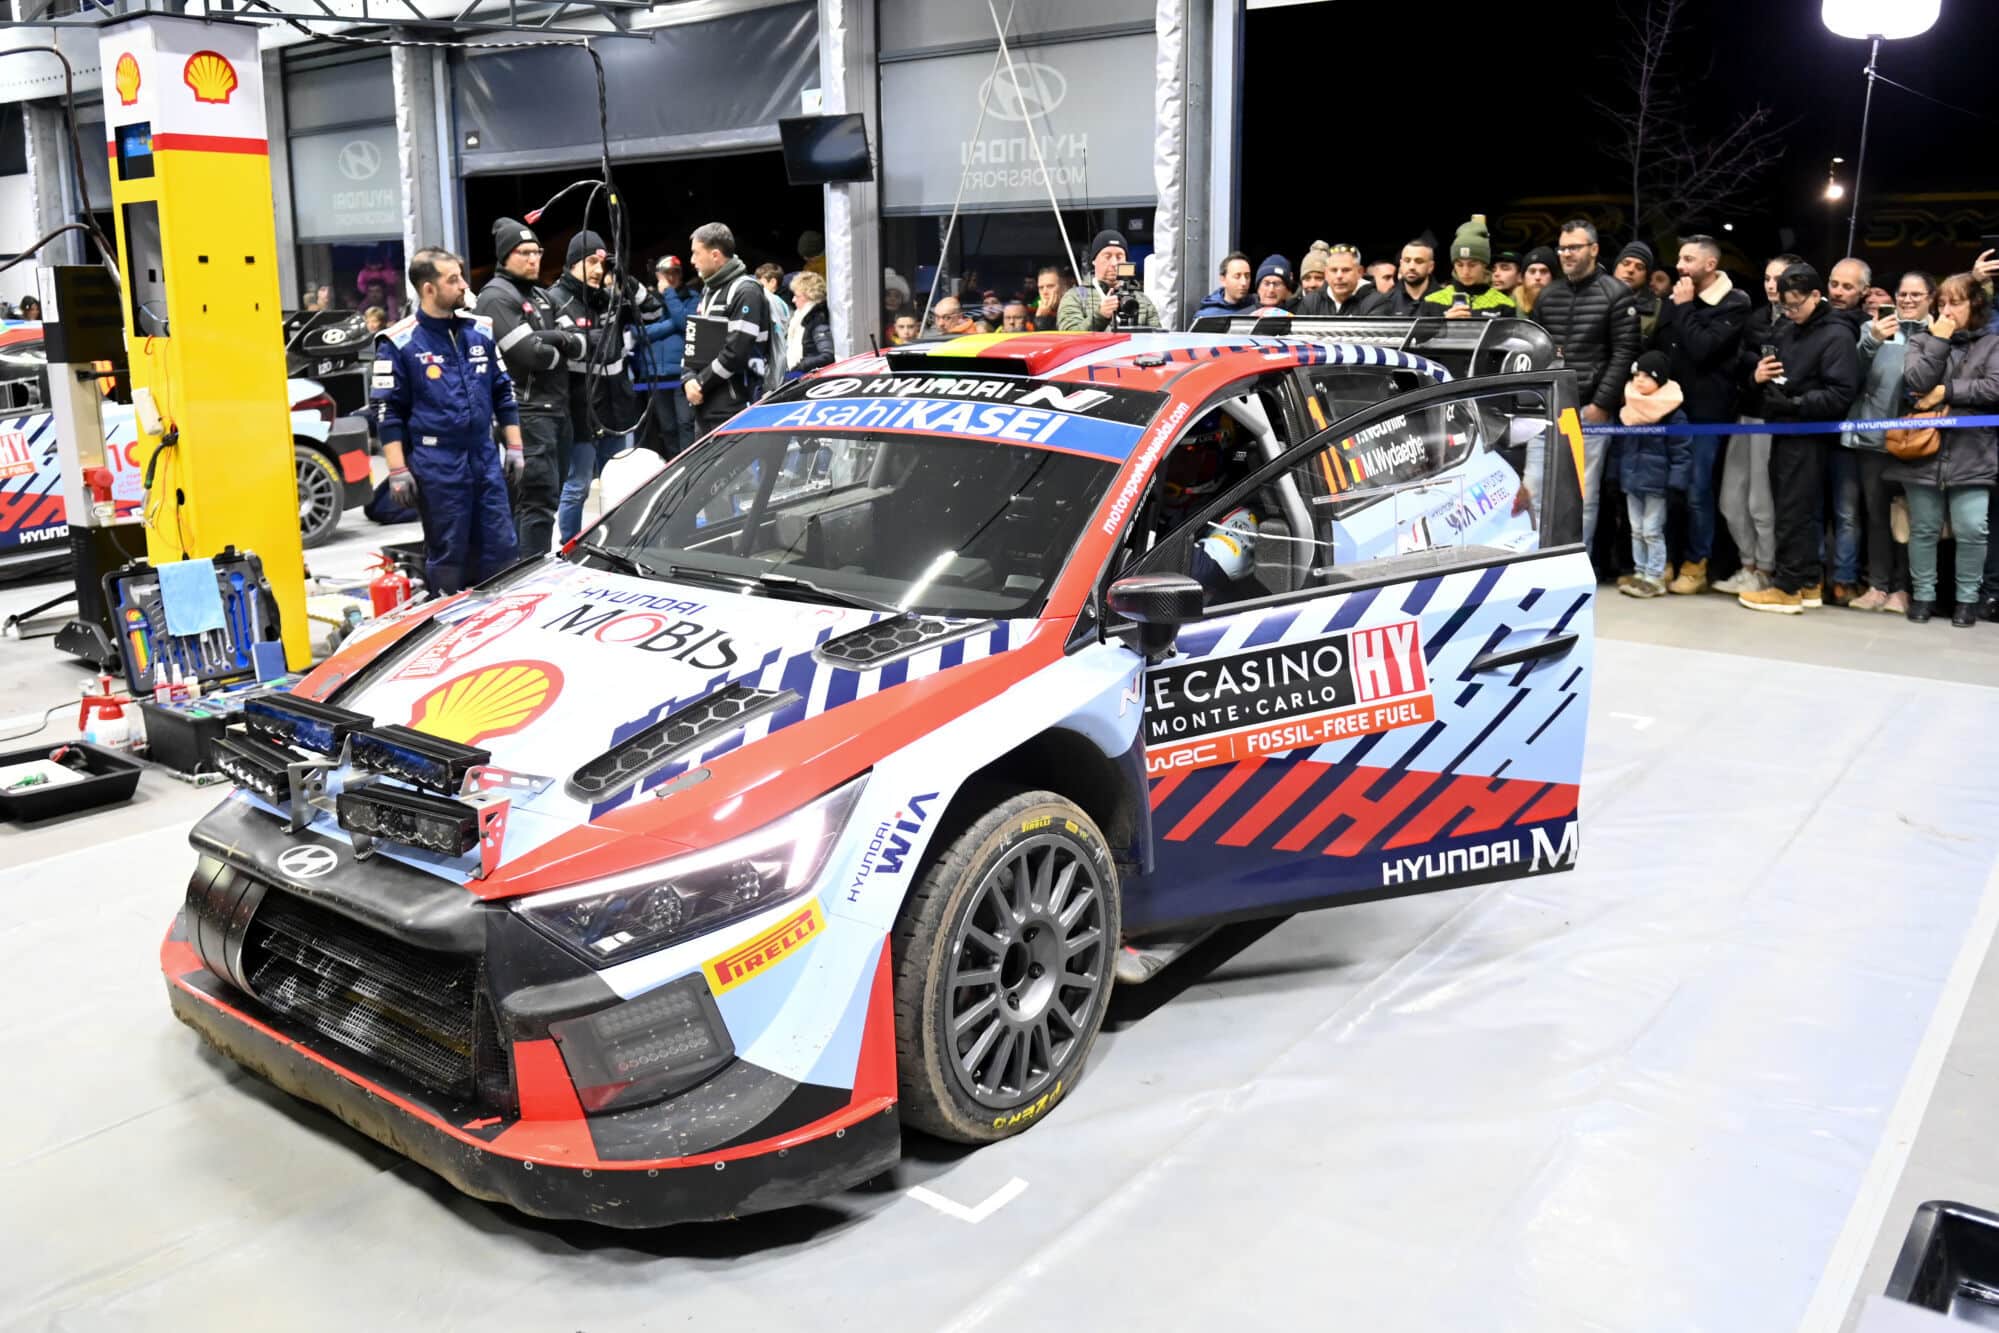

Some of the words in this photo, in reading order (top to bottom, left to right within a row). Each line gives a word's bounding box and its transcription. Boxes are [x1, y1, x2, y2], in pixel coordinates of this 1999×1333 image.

[862, 377, 1014, 399] HYUNDAI
[577, 587, 708, 616] HYUNDAI
[540, 604, 738, 669] MOBIS
[1353, 622, 1423, 701] HY
[1145, 677, 1175, 712] E
[1183, 645, 1343, 703] CASINO
[1145, 743, 1218, 773] WRC
[1247, 711, 1370, 753] FOSSIL-FREE
[1375, 703, 1422, 725] FUEL
[847, 821, 892, 903] HYUNDAI
[875, 792, 940, 874] WIA
[1382, 839, 1520, 886] HYUNDAI
[713, 909, 816, 986] PIRELLI
